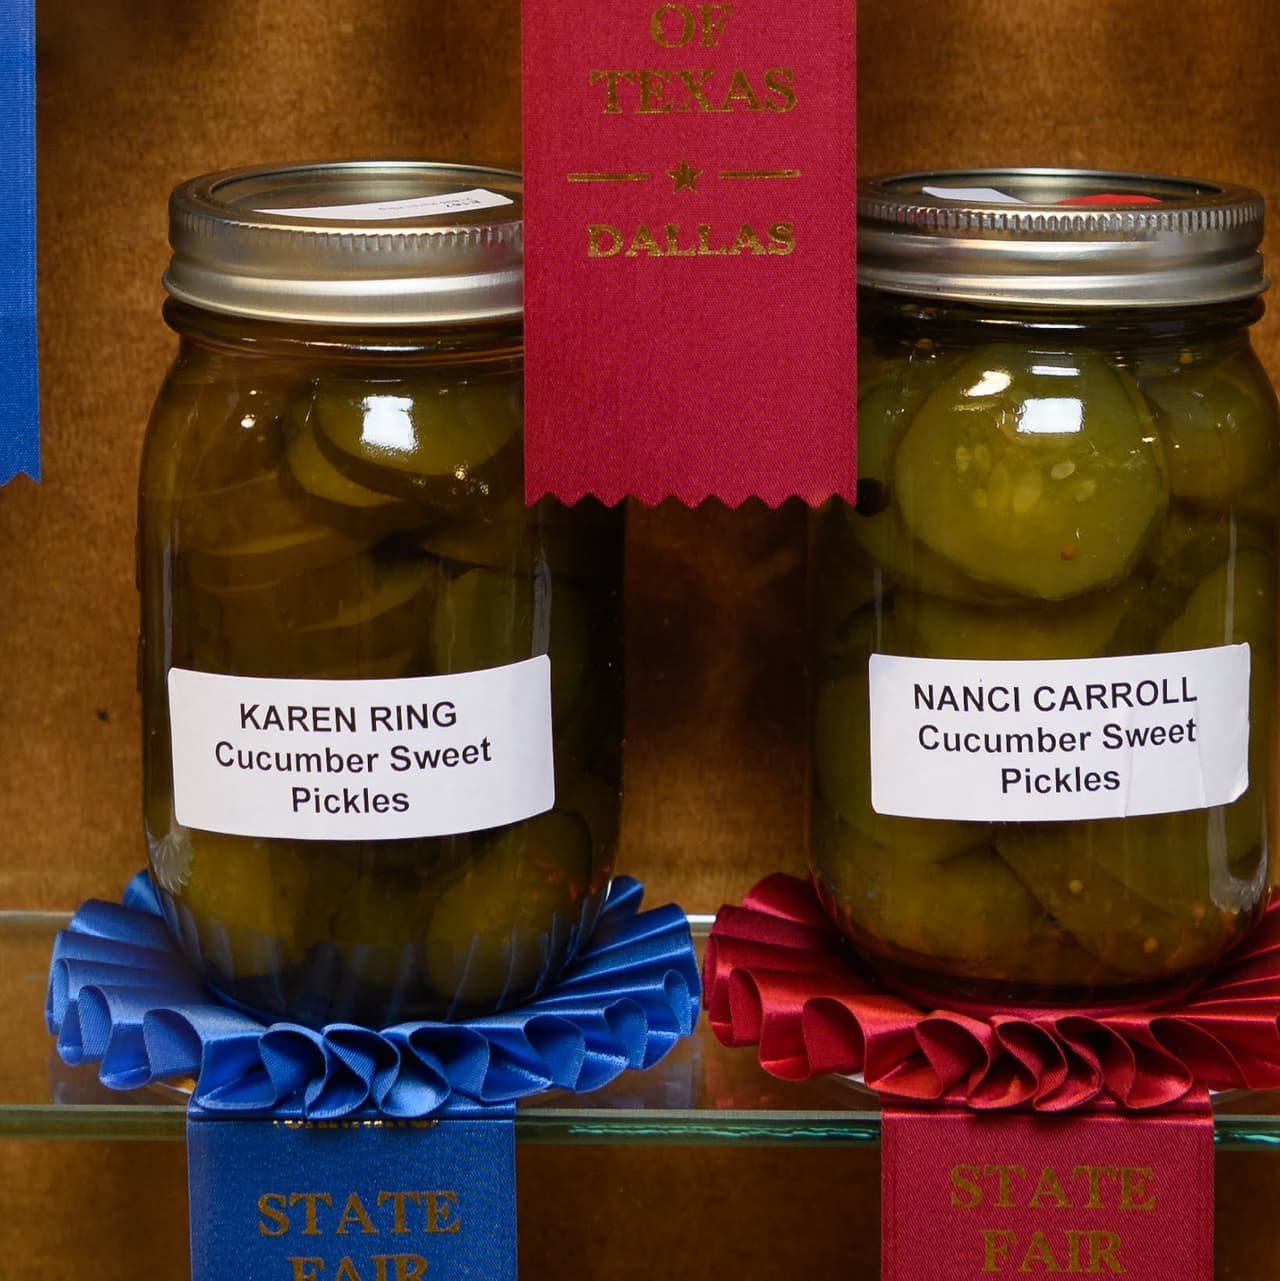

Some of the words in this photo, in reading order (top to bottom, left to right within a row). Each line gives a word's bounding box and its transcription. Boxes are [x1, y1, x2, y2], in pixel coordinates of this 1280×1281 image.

[650, 2, 734, 48] OF
[588, 67, 798, 114] TEXAS
[586, 222, 796, 257] DALLAS
[913, 683, 1021, 713] NANCI
[1033, 676, 1197, 712] CARROLL
[239, 703, 357, 732] KAREN
[370, 701, 458, 732] RING
[918, 724, 1091, 753] Cucumber
[1102, 718, 1197, 750] Sweet
[214, 740, 379, 773] Cucumber
[389, 736, 492, 772] Sweet
[1001, 766, 1121, 794] Pickles
[292, 786, 410, 814] Pickles
[950, 1164, 1157, 1210] STATE
[257, 1190, 461, 1236] STATE
[287, 1253, 428, 1281] FAIR
[979, 1228, 1126, 1273] FAIR
